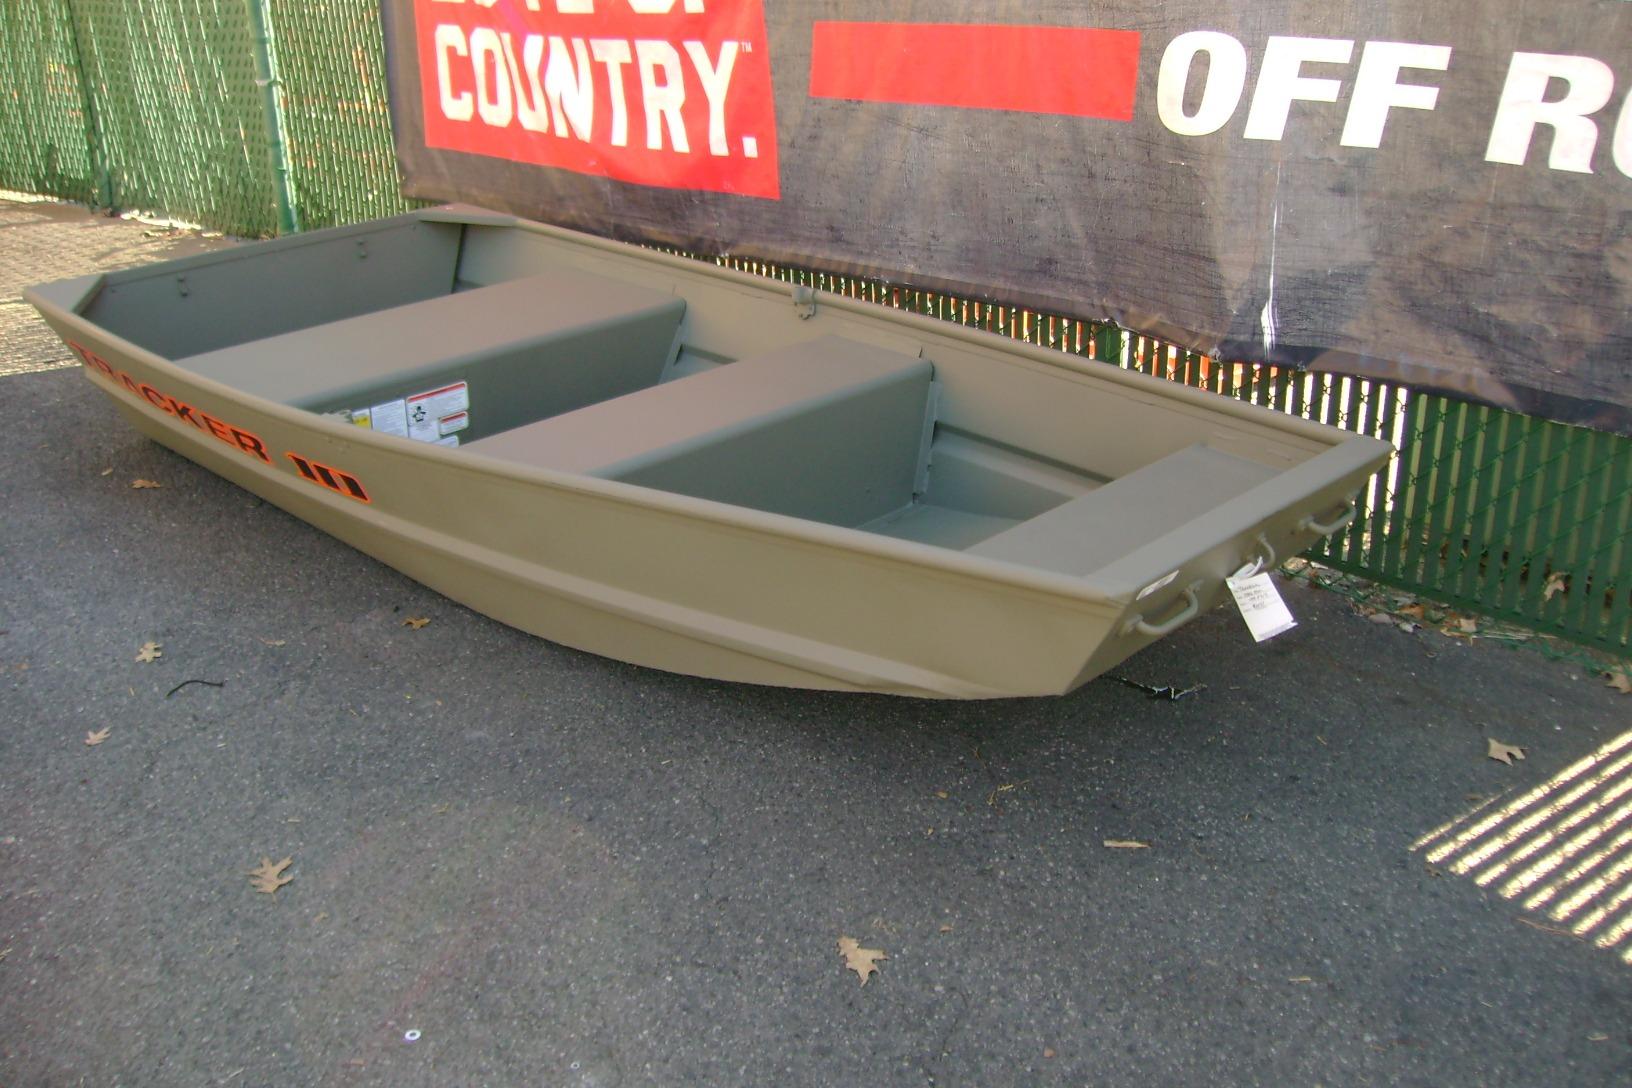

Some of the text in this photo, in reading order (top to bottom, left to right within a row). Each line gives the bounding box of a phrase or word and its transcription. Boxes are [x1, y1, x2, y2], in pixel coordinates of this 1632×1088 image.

[435, 24, 758, 158] COUNTRY.
[1157, 30, 1632, 179] OFF R
[65, 339, 273, 464] TRACKER
